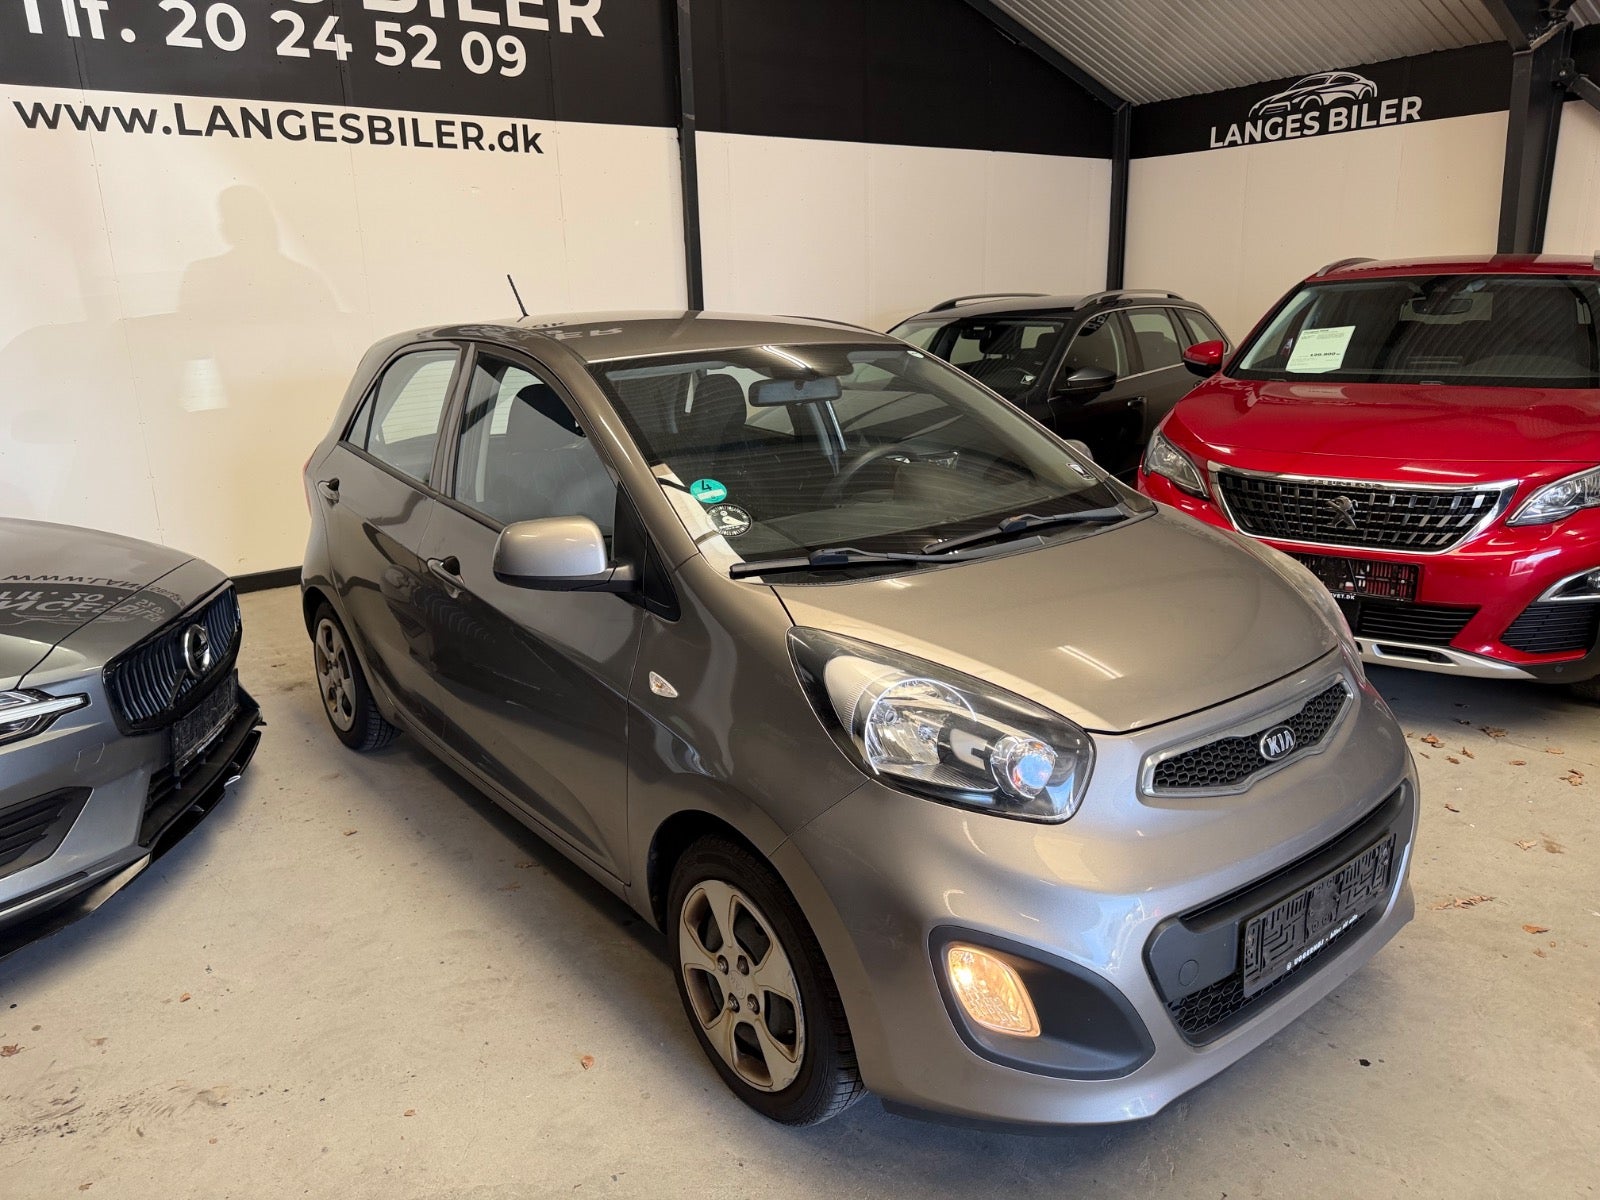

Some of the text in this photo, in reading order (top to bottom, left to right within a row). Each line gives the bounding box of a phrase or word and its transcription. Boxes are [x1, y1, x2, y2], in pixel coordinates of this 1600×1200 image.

[158, 0, 247, 51] 20
[270, 10, 353, 61] 24
[375, 20, 442, 70] 52
[461, 31, 527, 77] 09
[13, 100, 544, 154] www.LANGESBILER.dk
[1210, 96, 1422, 148] LANGES BILER
[1266, 730, 1294, 756] KIA
